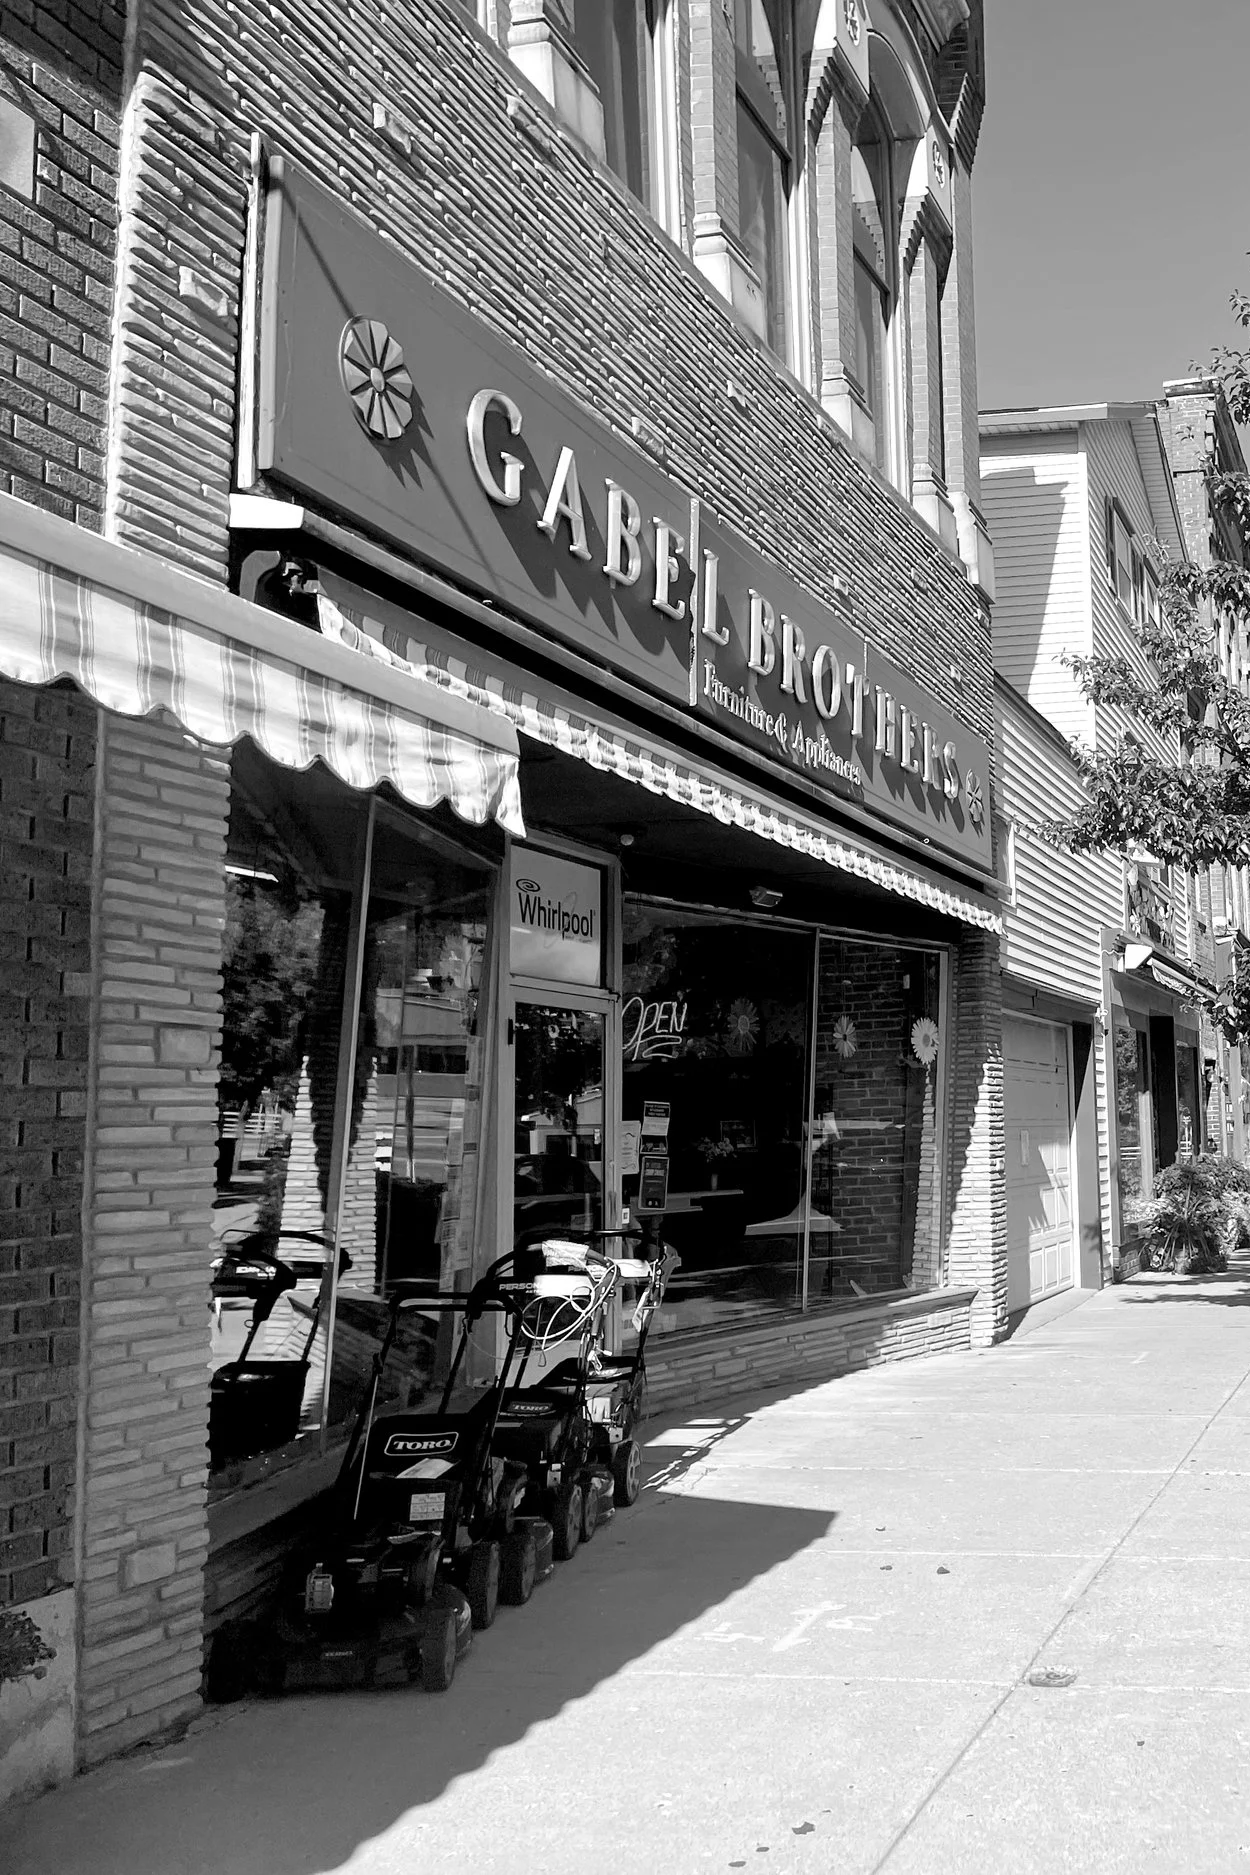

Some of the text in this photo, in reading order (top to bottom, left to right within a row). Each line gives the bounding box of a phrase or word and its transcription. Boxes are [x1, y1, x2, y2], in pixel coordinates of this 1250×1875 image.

[465, 388, 960, 800] GABEL BROTHERS
[703, 658, 861, 786] Furniture & Appliances
[517, 892, 594, 941] Whirlpool
[621, 996, 688, 1062] OPEN
[499, 1280, 541, 1292] PERSON
[512, 1404, 549, 1412] TORO
[393, 1438, 453, 1451] TORO
